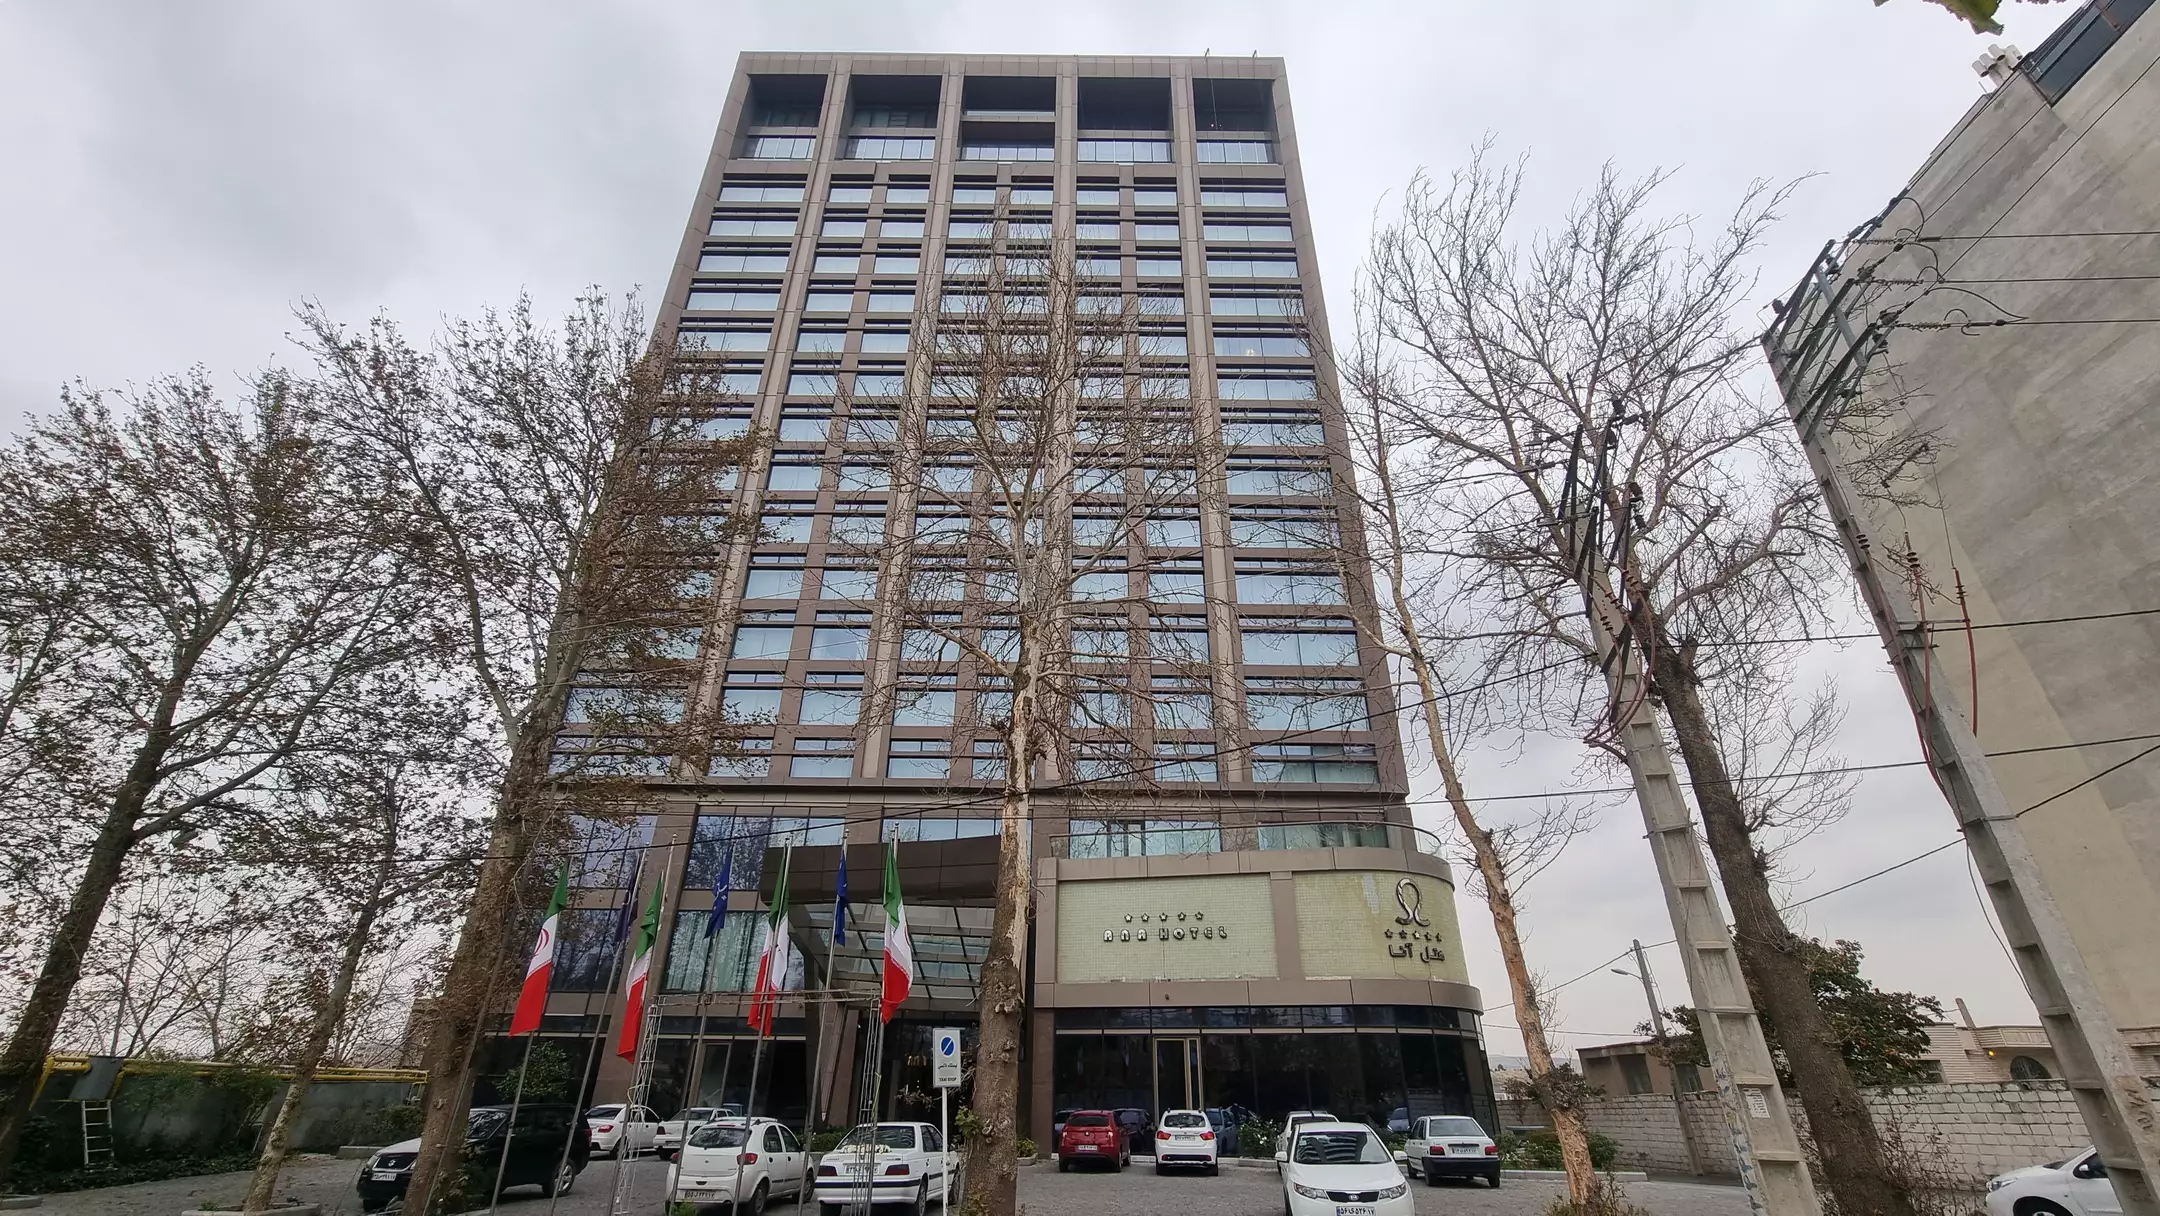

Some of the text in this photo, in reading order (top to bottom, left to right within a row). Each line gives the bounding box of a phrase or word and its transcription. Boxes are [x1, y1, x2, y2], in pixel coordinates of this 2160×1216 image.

[1159, 926, 1228, 941] HOTEL
[1388, 942, 1445, 963] هتل آنا
